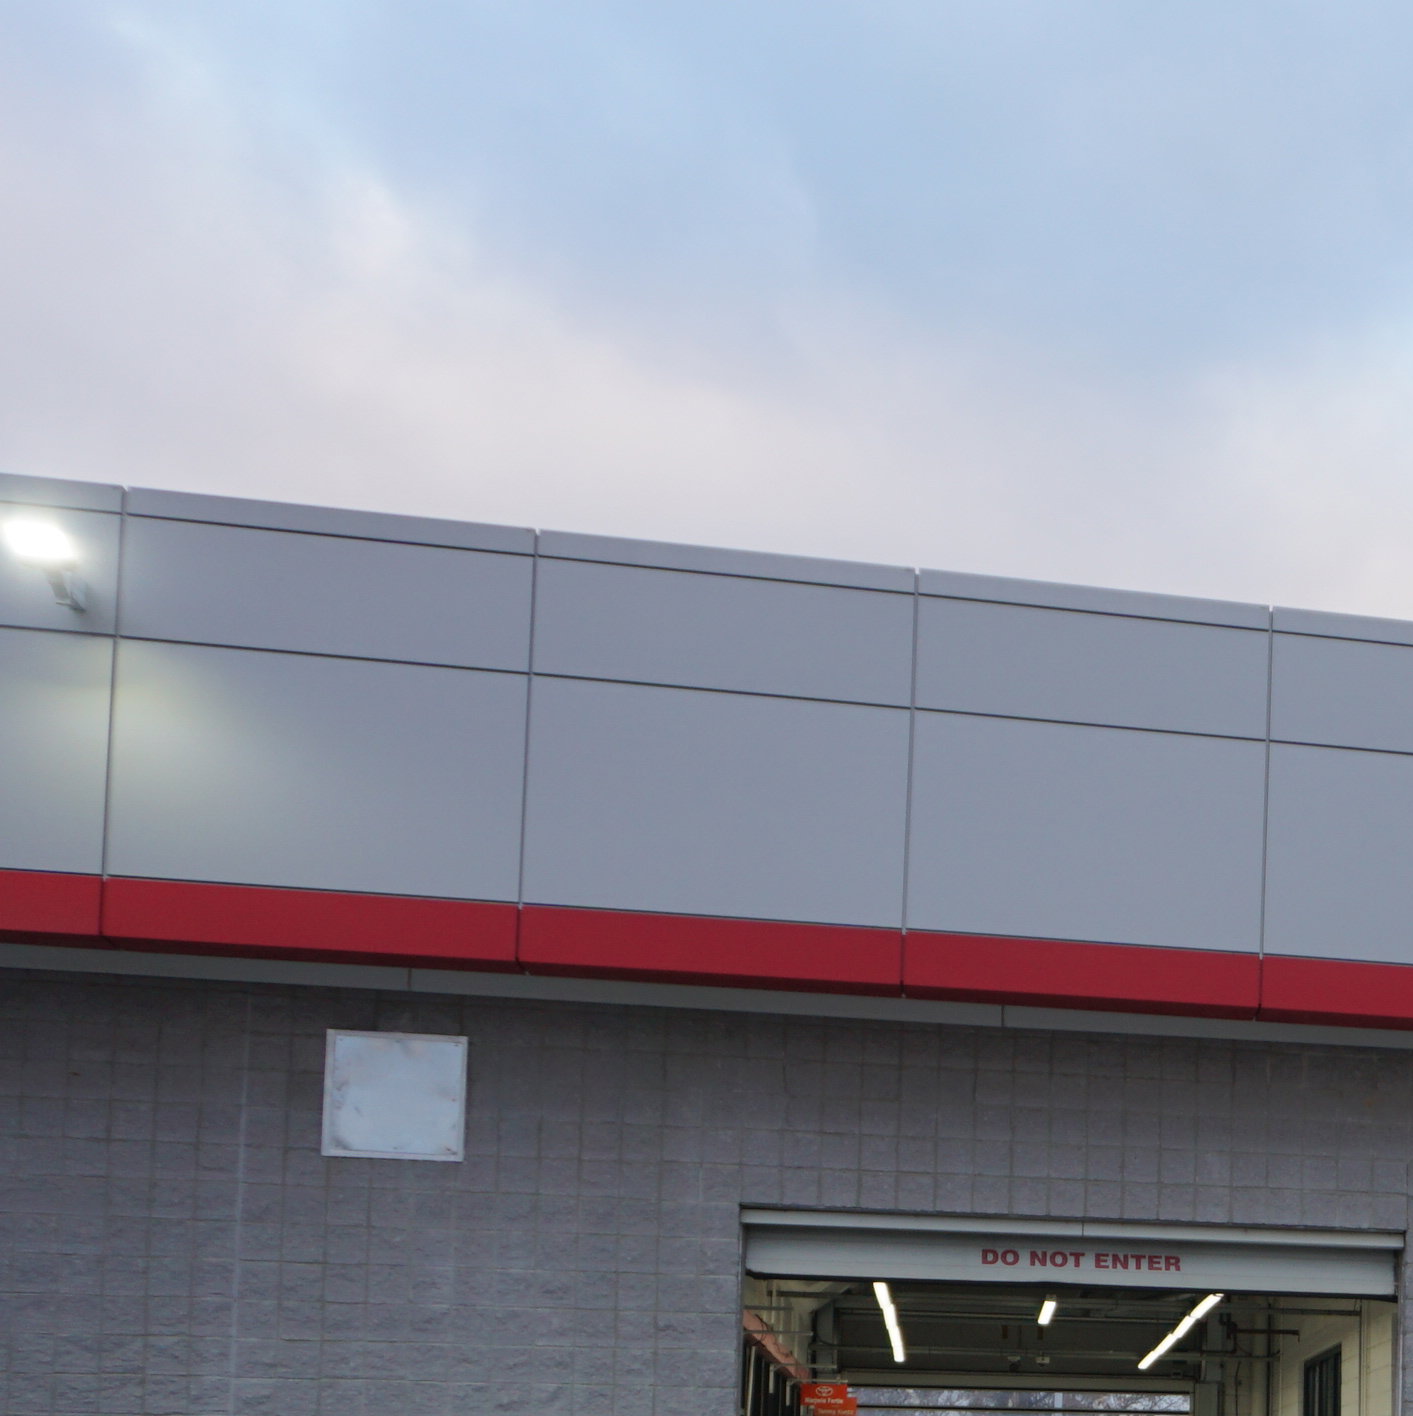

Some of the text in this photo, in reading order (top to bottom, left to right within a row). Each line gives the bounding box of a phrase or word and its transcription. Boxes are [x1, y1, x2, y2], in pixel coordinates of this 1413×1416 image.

[981, 1248, 1181, 1271] DO NOT ENTER
